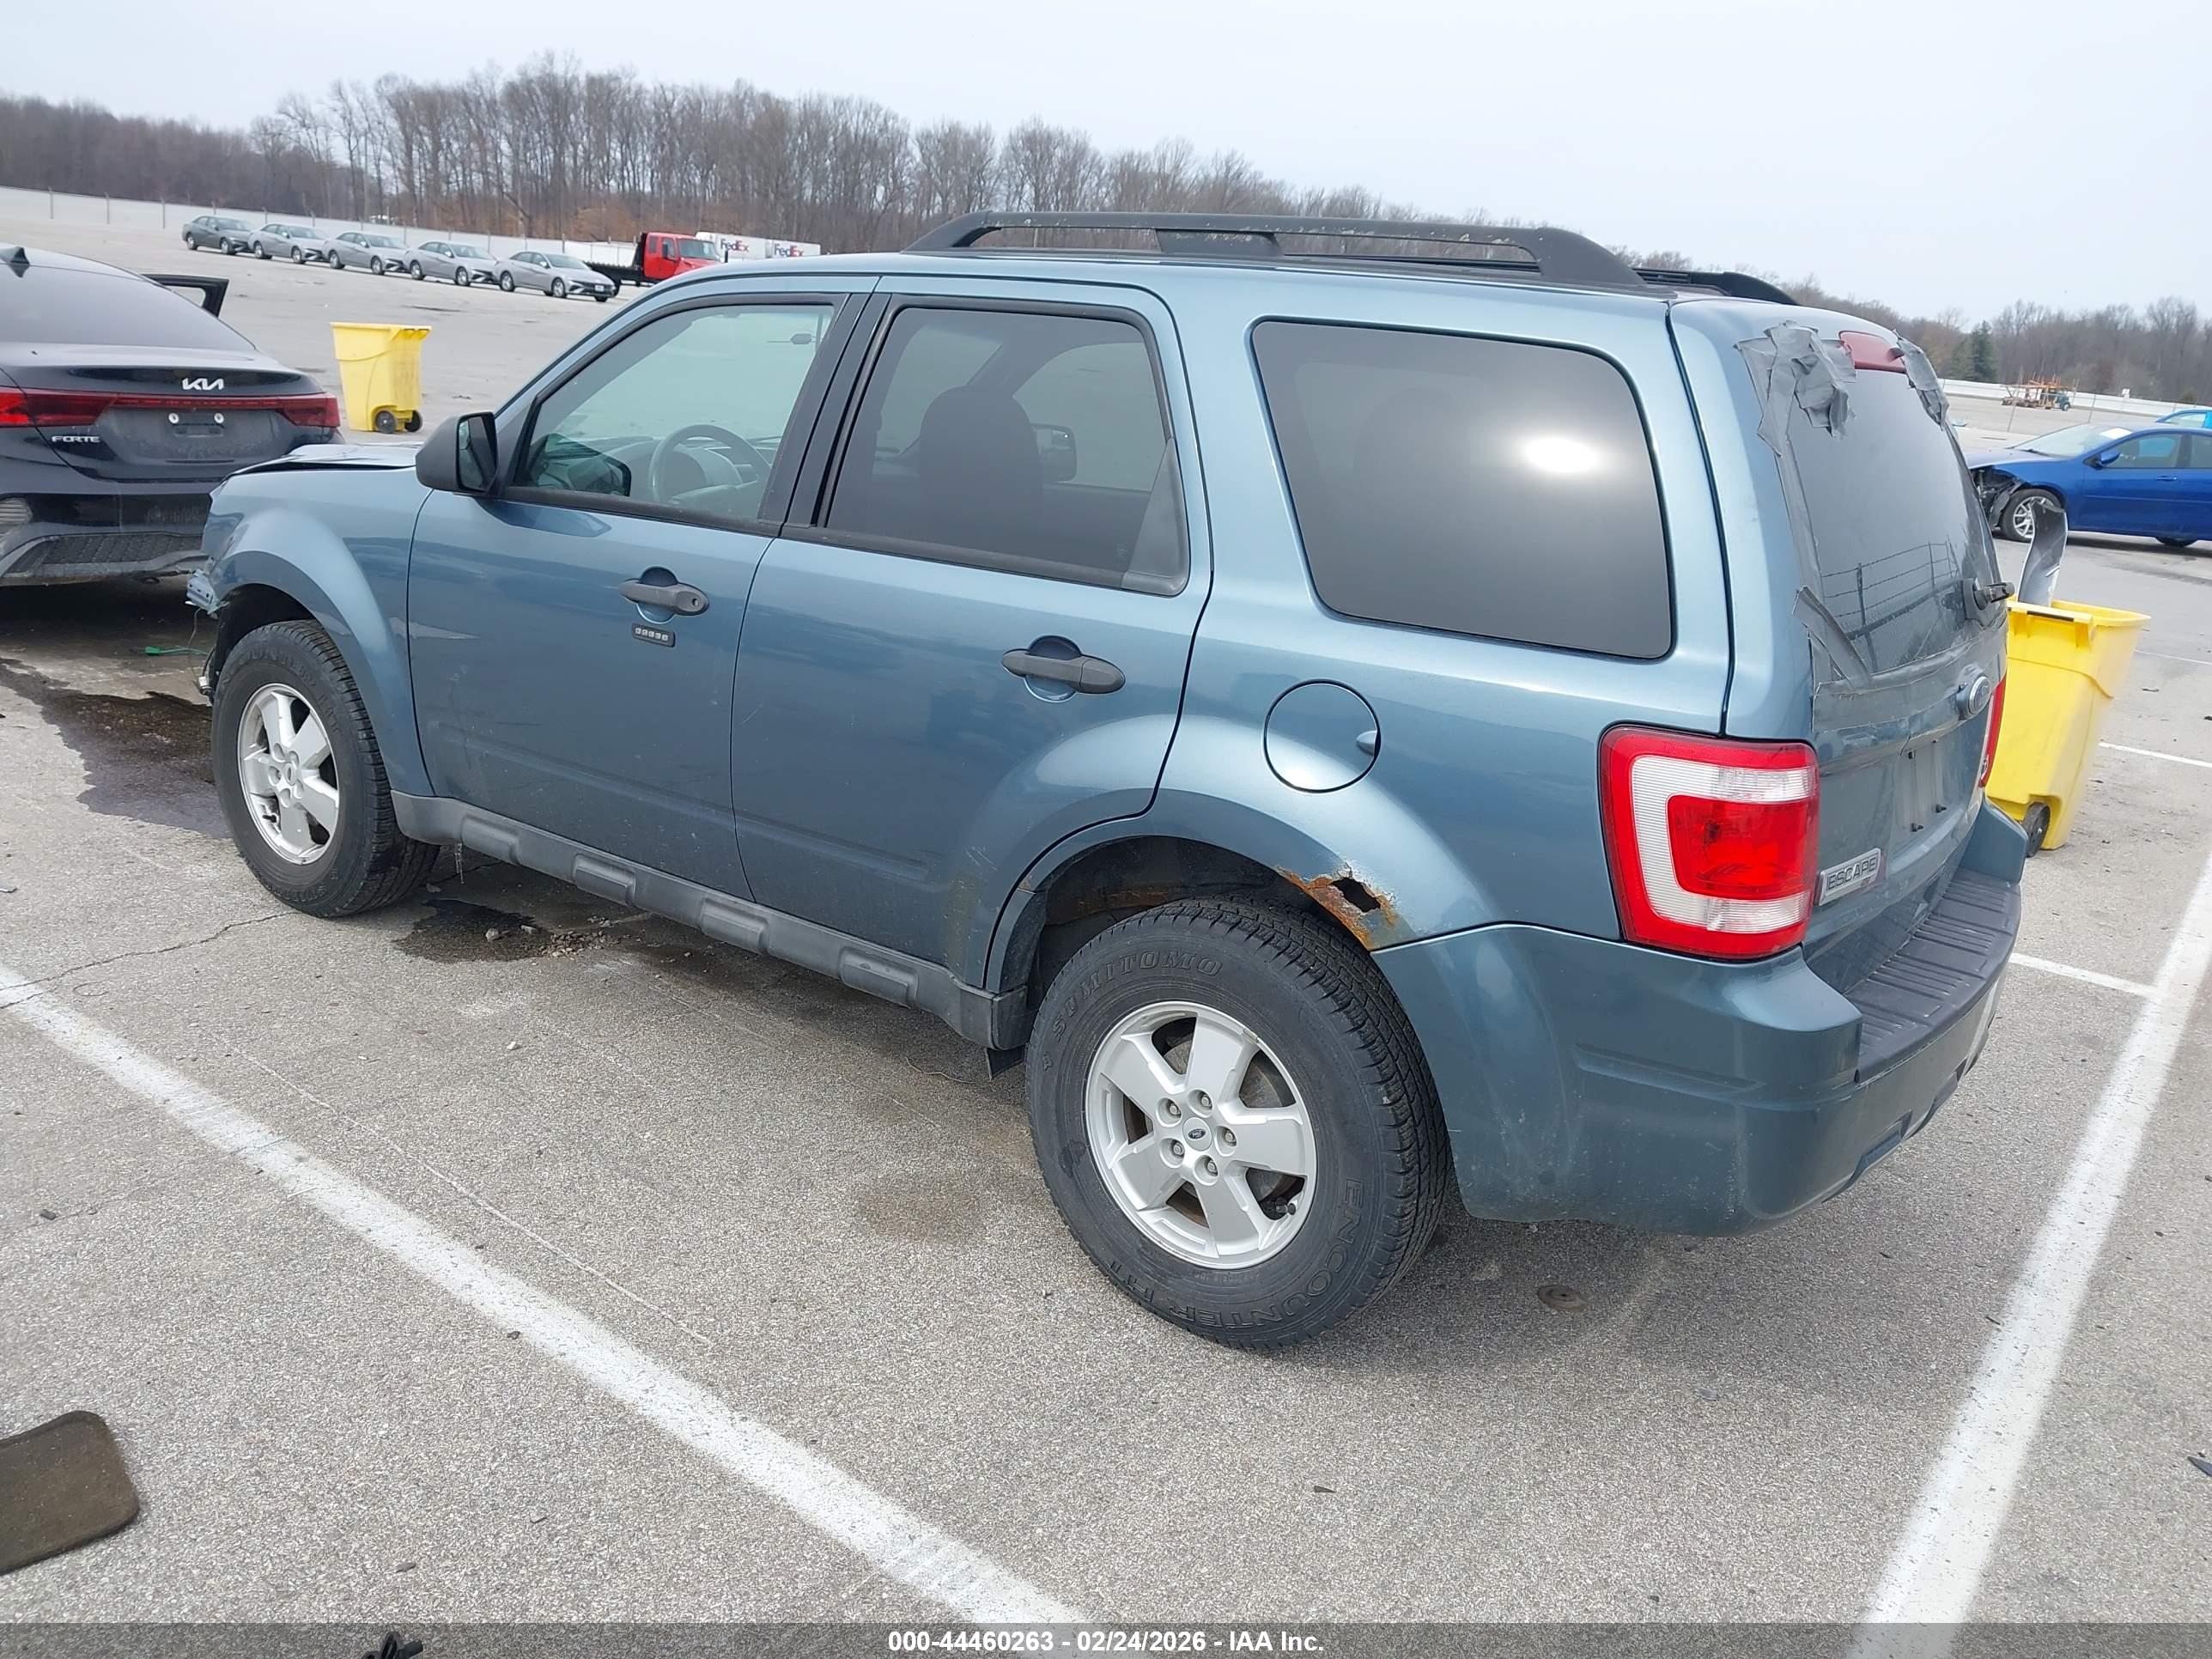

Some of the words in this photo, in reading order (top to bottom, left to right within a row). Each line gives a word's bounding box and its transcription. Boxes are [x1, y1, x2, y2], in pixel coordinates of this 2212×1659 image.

[720, 238, 750, 252] FedEx
[774, 243, 804, 257] FedEx
[182, 378, 224, 391] KIA
[1826, 855, 1878, 890] ESCAPE
[1052, 949, 1224, 1042] SUMITOMO
[1169, 1178, 1364, 1329] ENCOUNTER
